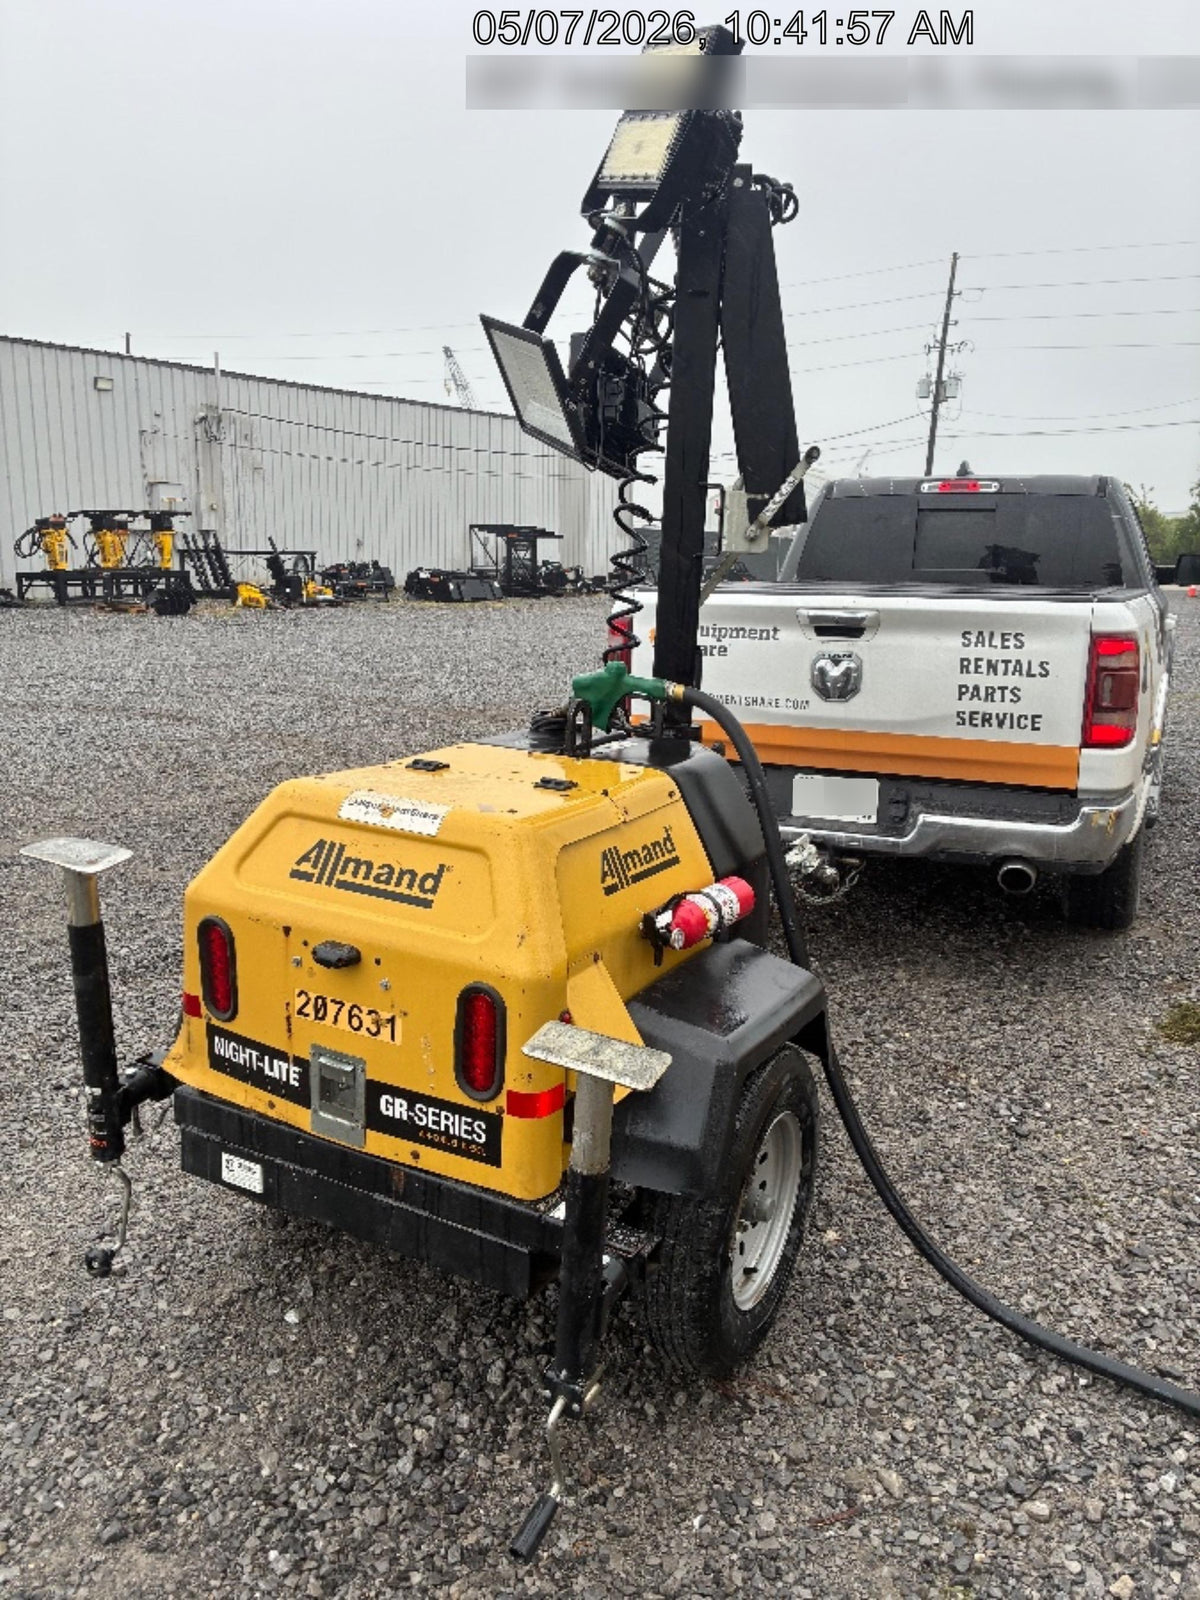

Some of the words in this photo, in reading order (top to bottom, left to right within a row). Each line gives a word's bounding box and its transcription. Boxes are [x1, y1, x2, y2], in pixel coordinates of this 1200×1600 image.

[699, 624, 781, 642] uipment
[961, 630, 1025, 649] SALES
[700, 644, 728, 657] are
[959, 657, 1050, 678] RENTALS
[957, 684, 1021, 704] PARTS
[956, 711, 1042, 731] SERVICE
[291, 838, 446, 895] Allmand
[601, 831, 677, 890] Allmand
[296, 989, 396, 1042] 207631
[214, 1035, 303, 1087] NIGHT-LITE
[379, 1094, 487, 1143] GR-SERIES
